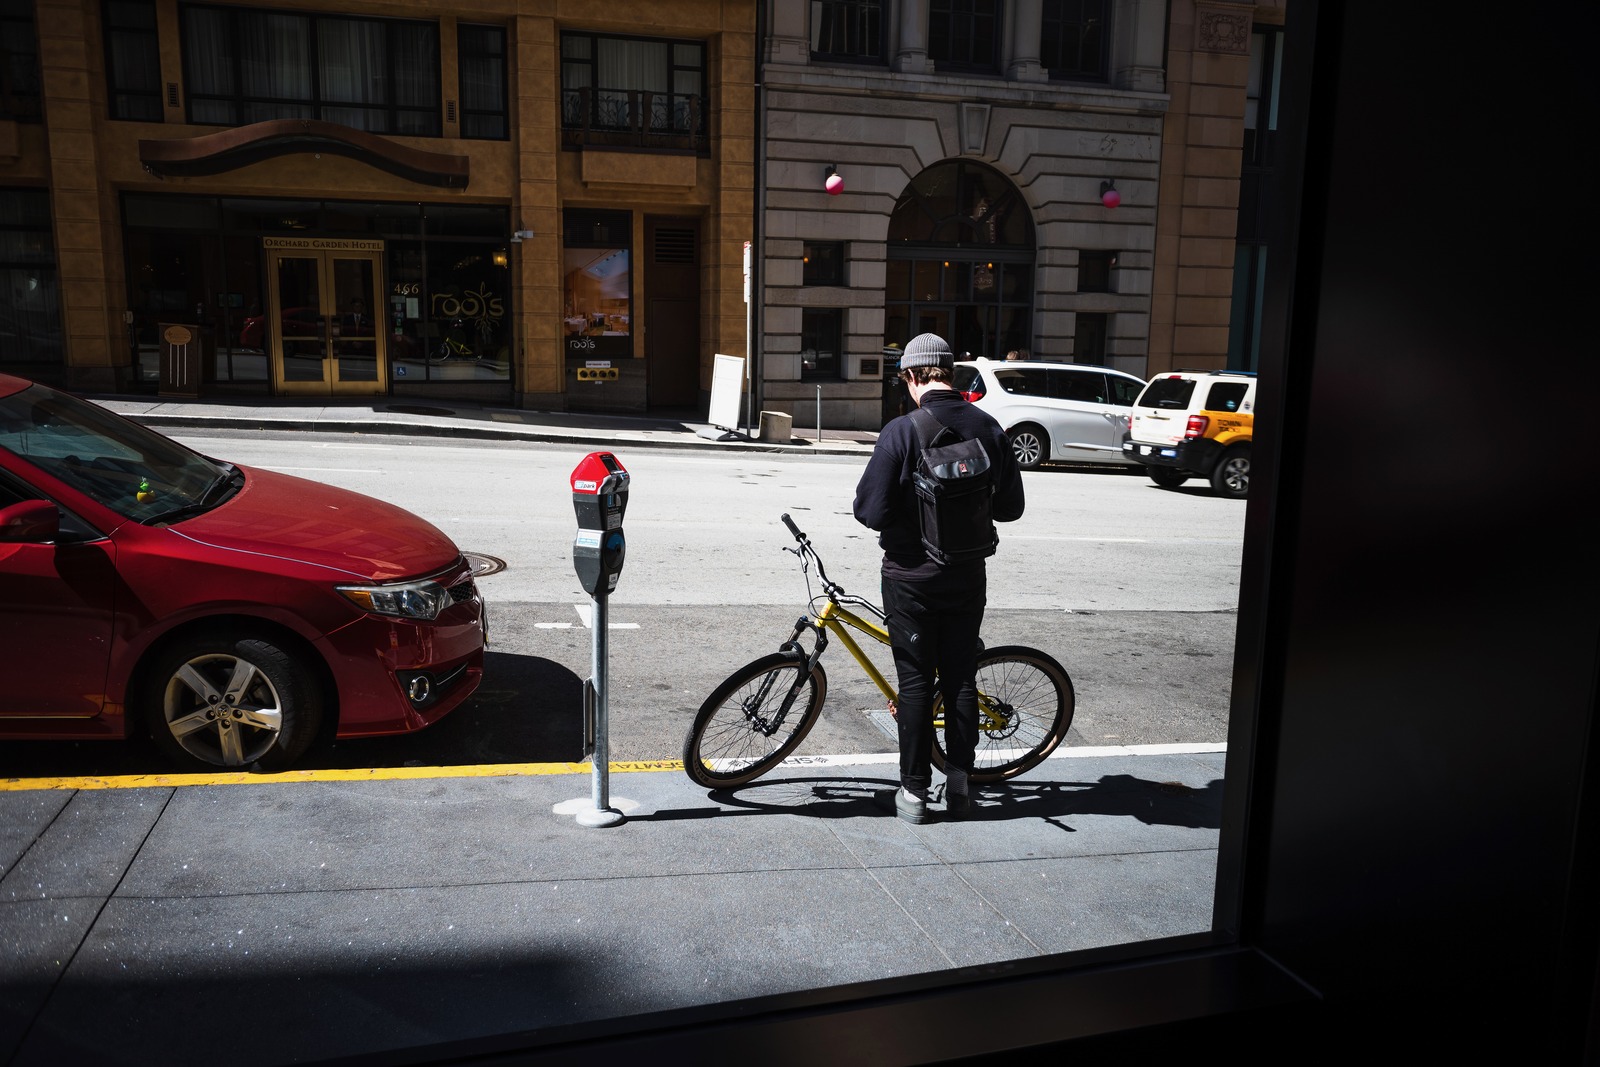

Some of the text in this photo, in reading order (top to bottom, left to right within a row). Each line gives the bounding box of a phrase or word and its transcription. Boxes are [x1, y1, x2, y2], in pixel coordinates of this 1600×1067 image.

[265, 239, 382, 249] ORCHARD GARDEN HOTEL
[394, 283, 419, 294] 466
